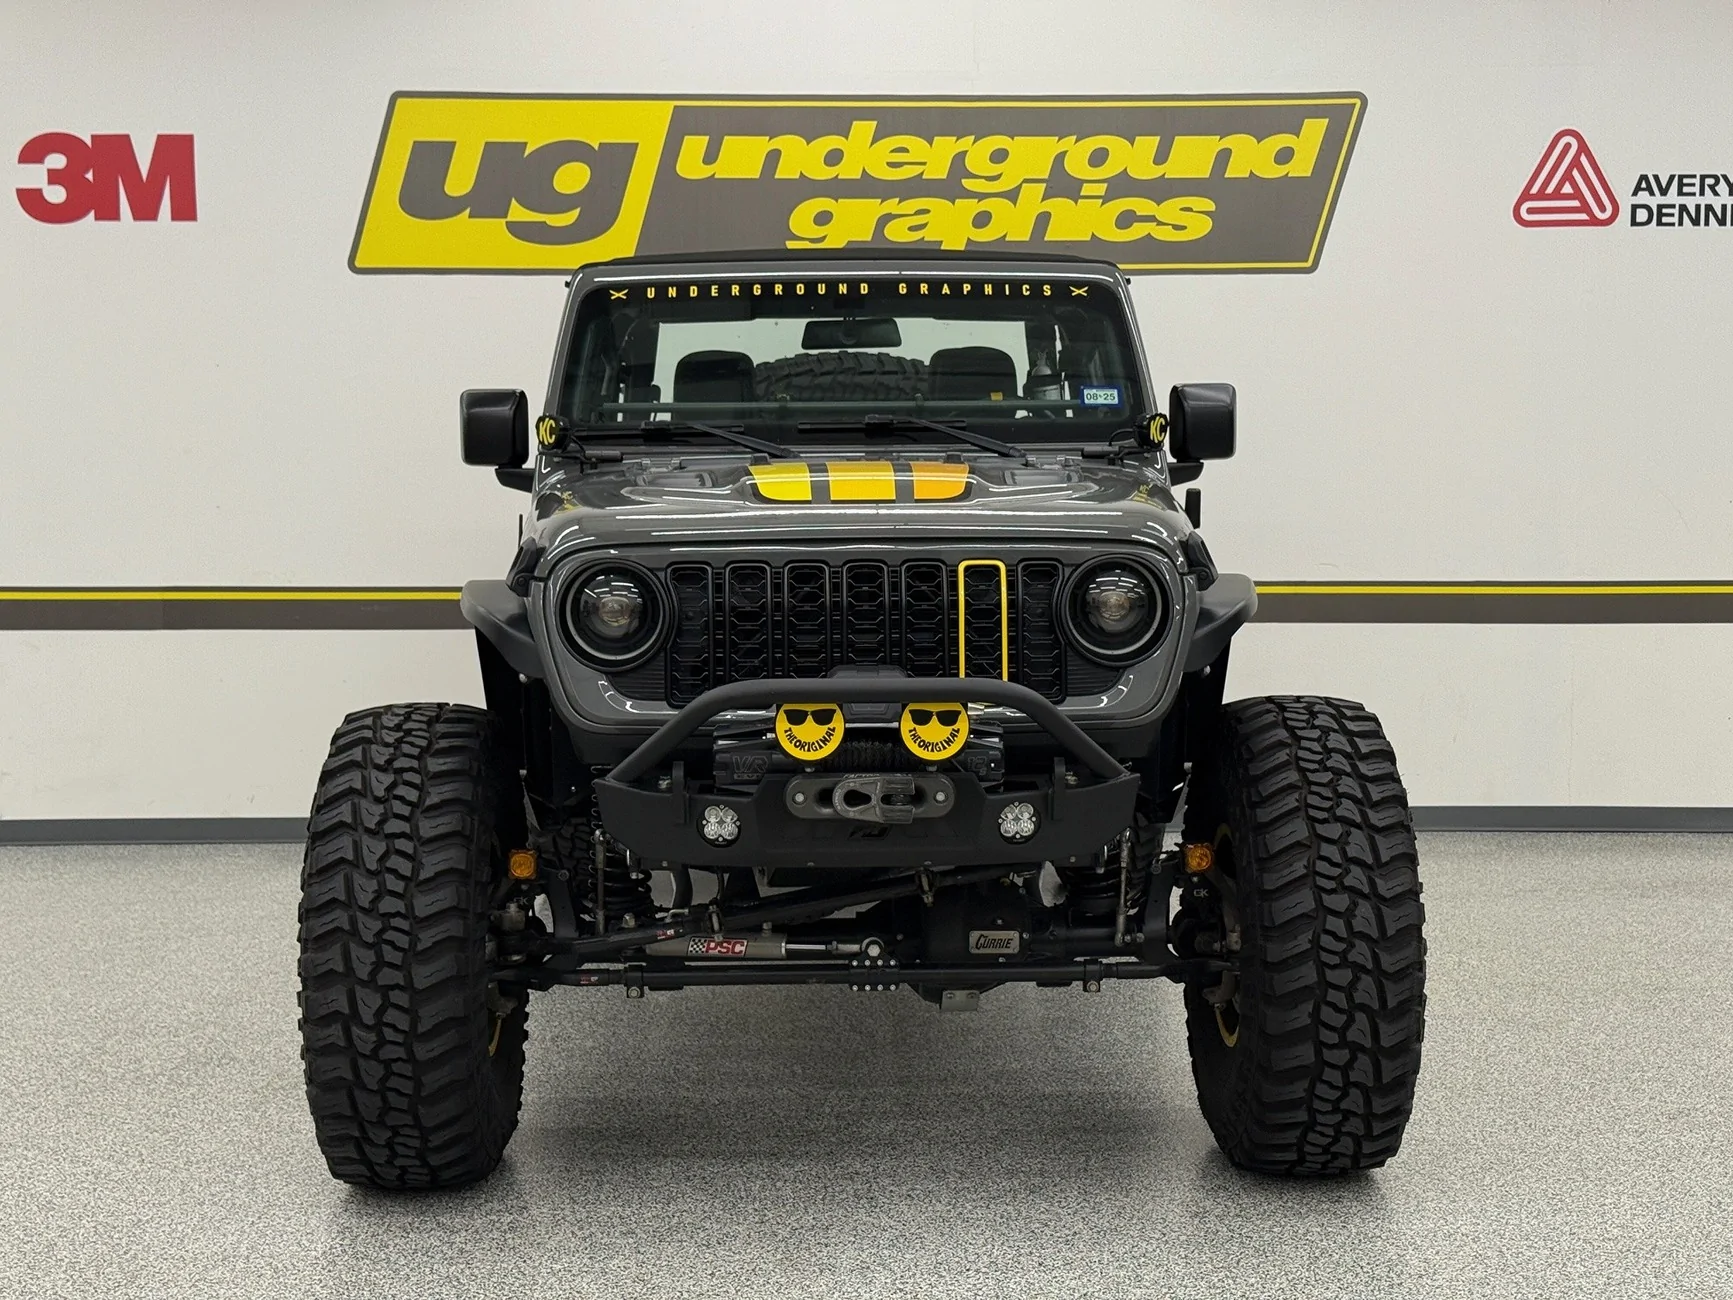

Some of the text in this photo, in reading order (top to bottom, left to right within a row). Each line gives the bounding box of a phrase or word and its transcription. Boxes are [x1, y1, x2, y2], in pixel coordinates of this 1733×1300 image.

[675, 119, 1329, 193] underground
[16, 132, 198, 224] 3M
[399, 140, 639, 246] ug
[786, 182, 1216, 251] graphics
[646, 283, 1052, 299] UNDERGROUND GRAPHICS
[539, 418, 556, 445] KC
[1150, 416, 1166, 443] KC
[705, 940, 746, 955] PSC
[975, 934, 1014, 950] CURRIE
